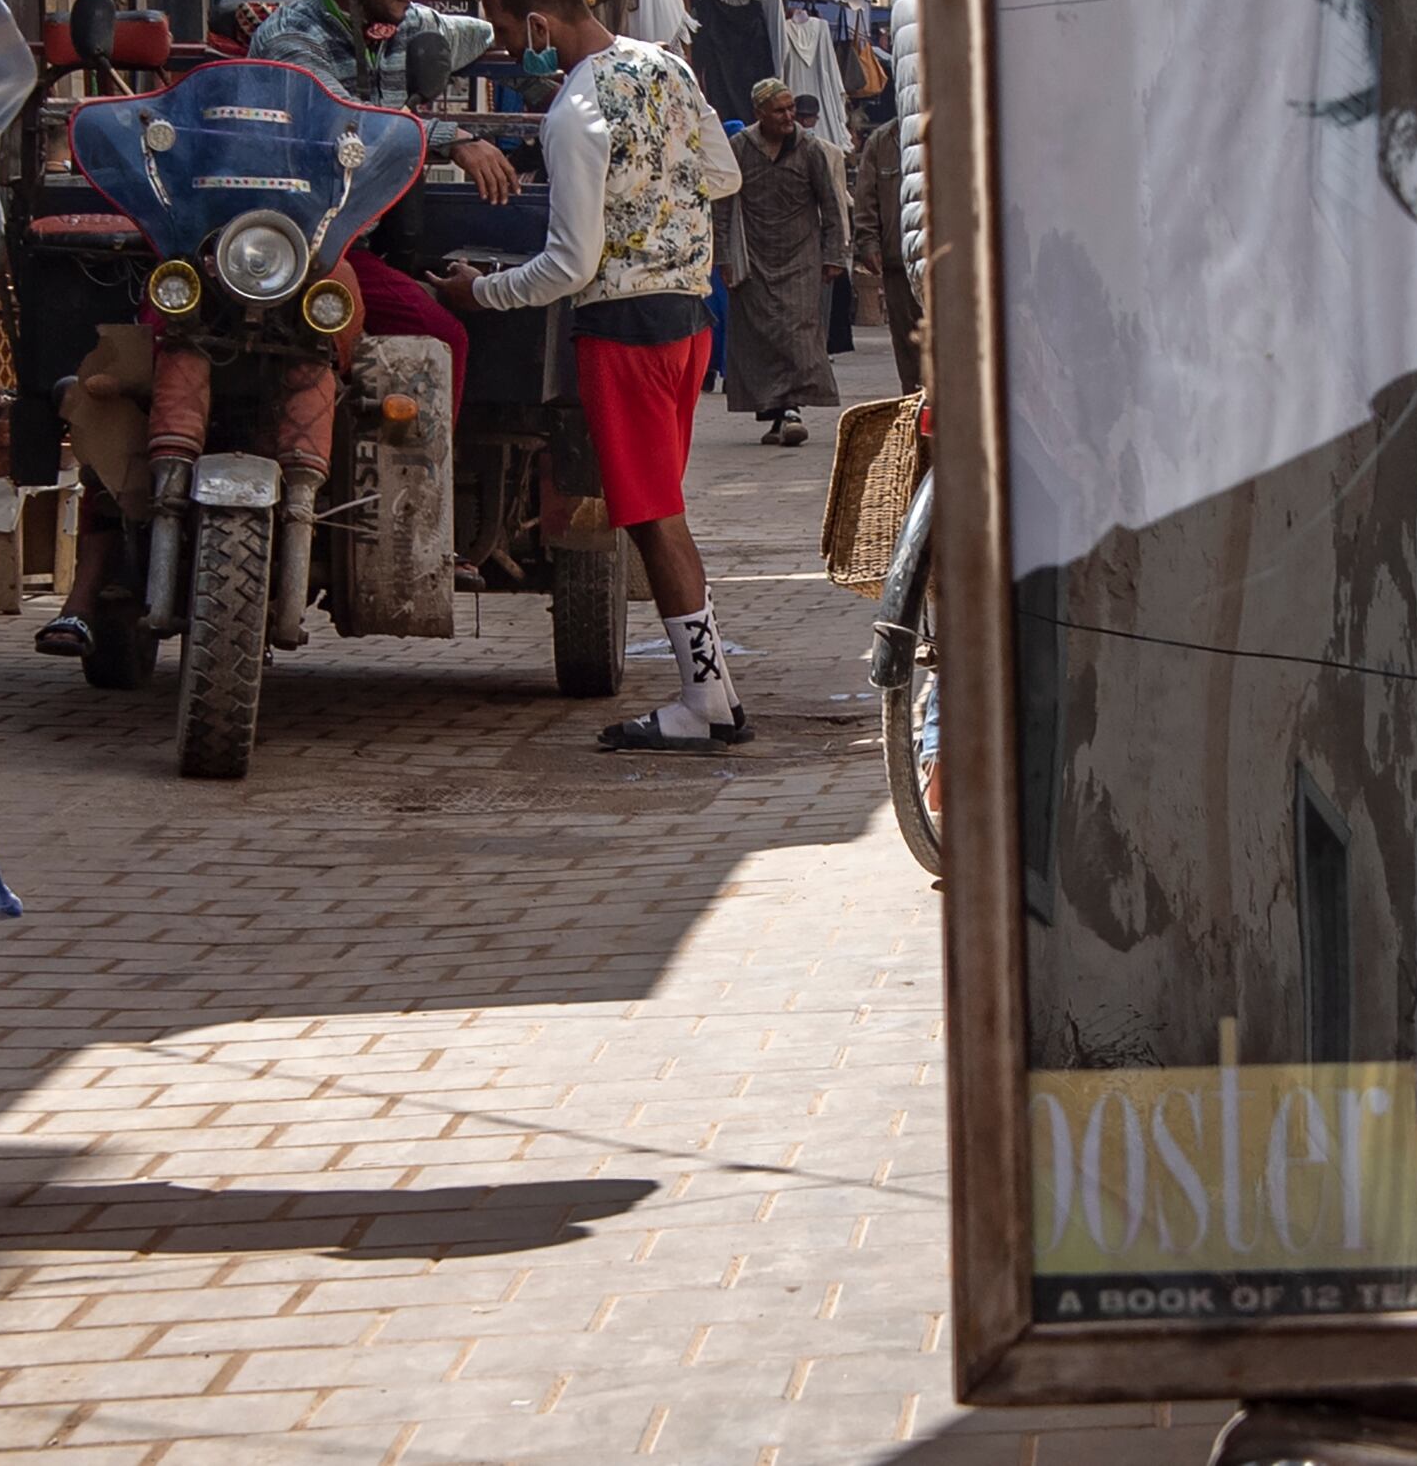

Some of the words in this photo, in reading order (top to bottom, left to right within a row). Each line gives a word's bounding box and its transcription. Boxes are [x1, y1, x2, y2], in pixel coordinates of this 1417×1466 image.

[1057, 1290, 1082, 1313] A
[1098, 1286, 1216, 1315] BOOK
[1230, 1284, 1285, 1312] OF
[1300, 1285, 1343, 1310] 12
